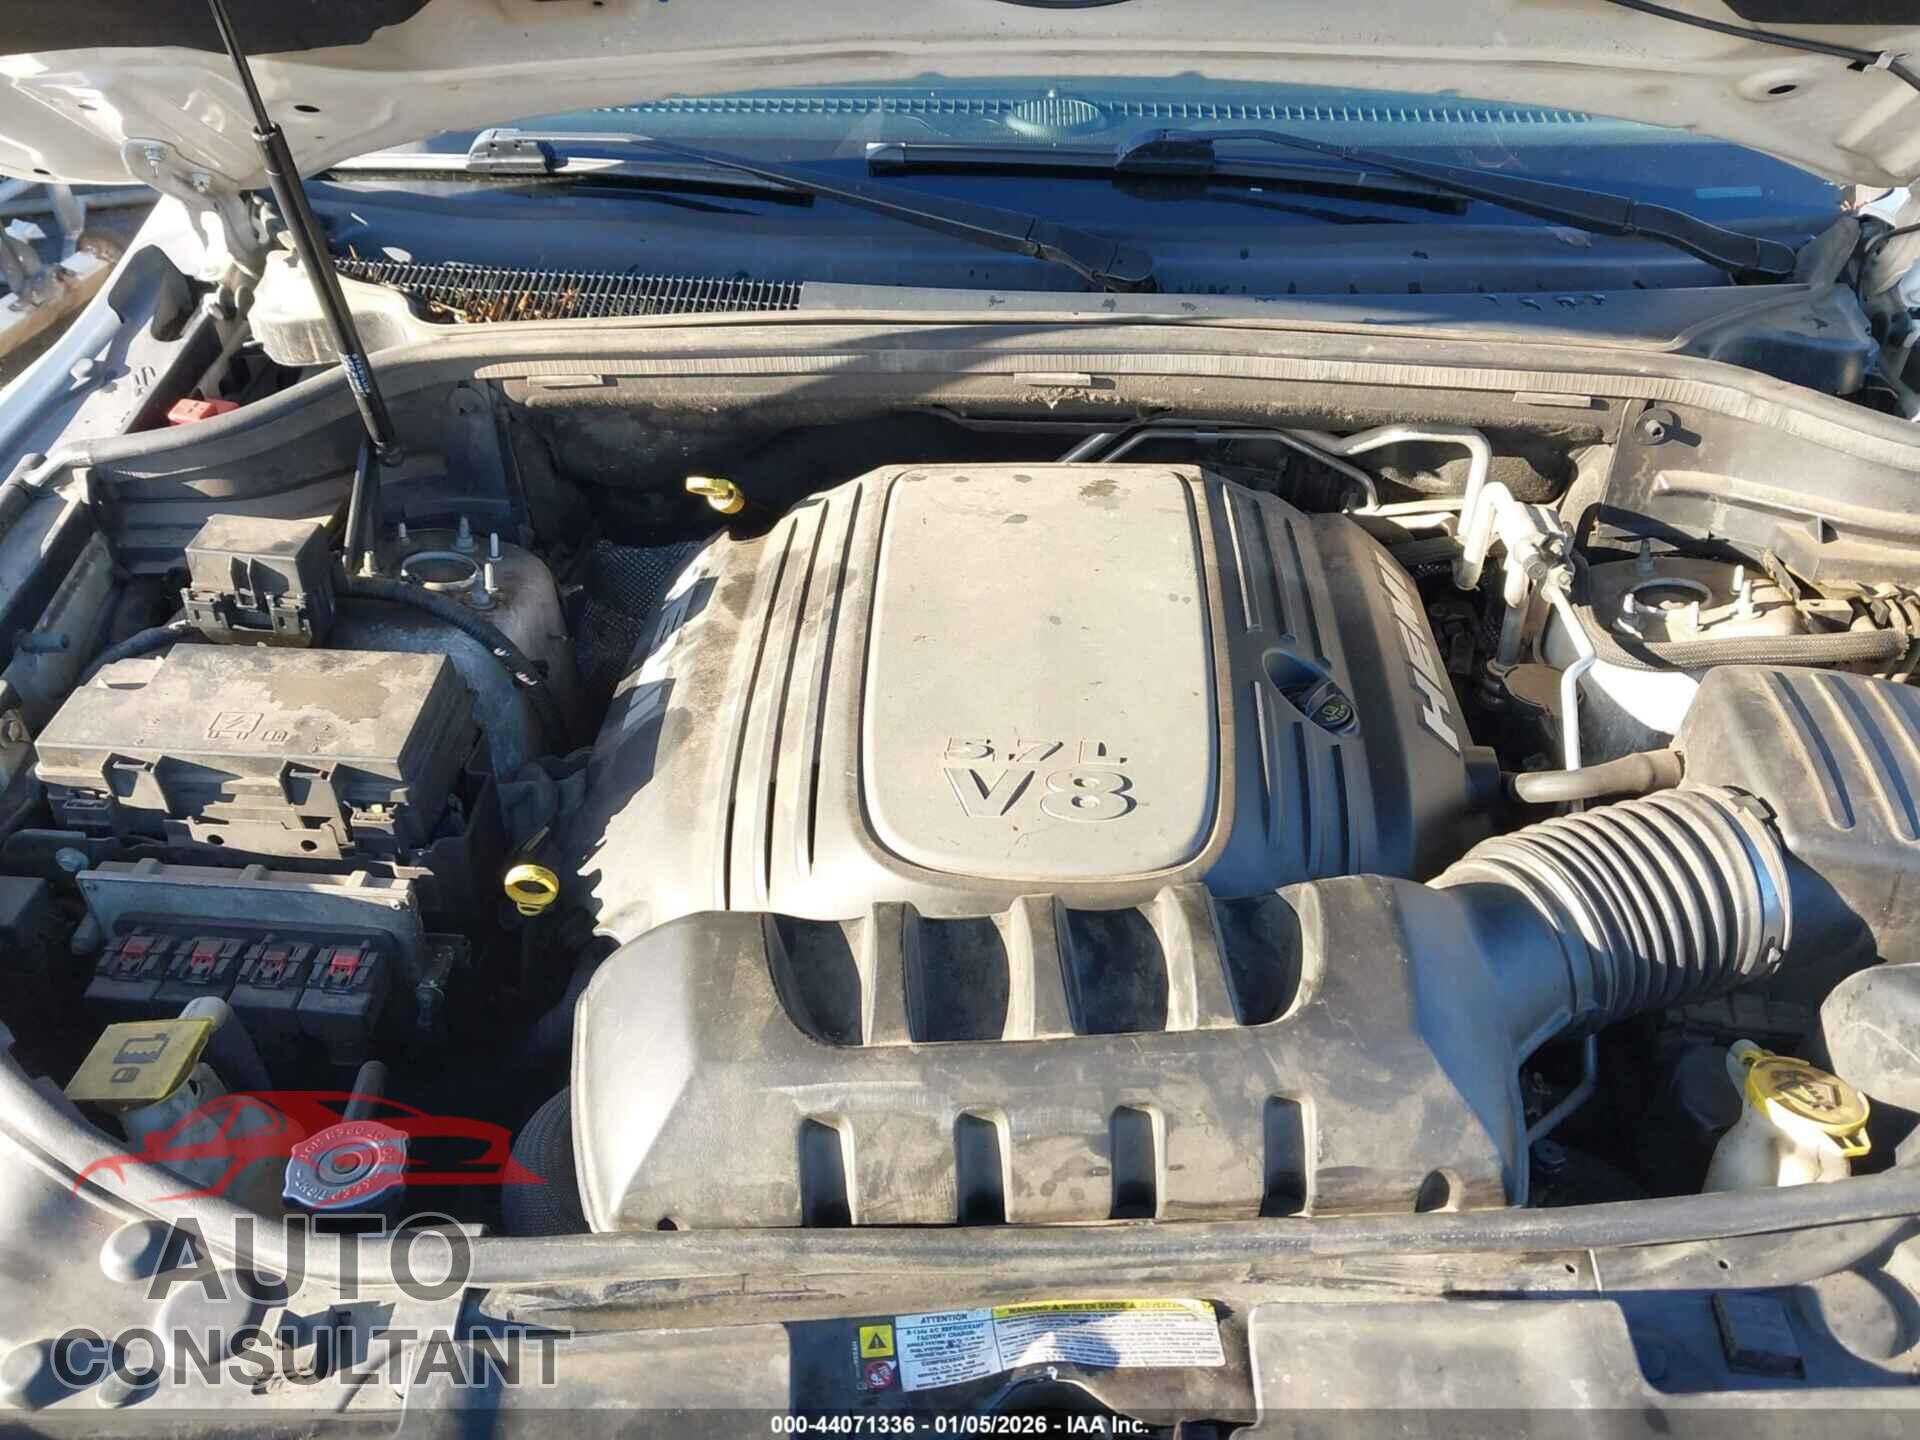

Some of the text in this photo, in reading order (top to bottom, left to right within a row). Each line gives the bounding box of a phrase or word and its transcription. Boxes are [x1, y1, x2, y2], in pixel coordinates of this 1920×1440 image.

[1374, 551, 1460, 752] HEMI
[944, 735, 1128, 765] 5.7L
[943, 767, 1138, 823] V8
[921, 1313, 968, 1324] ATTENTION
